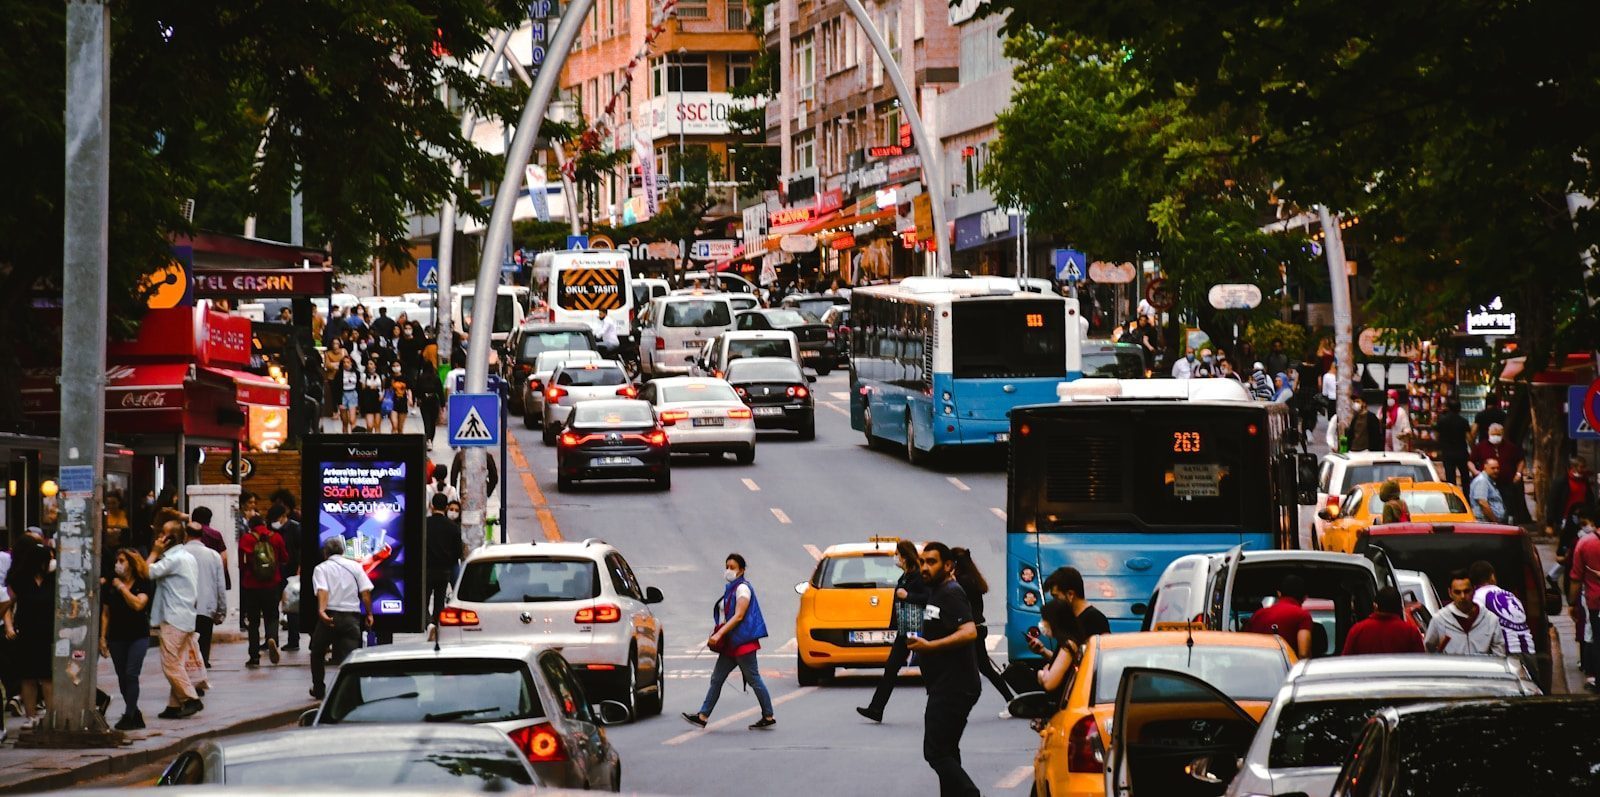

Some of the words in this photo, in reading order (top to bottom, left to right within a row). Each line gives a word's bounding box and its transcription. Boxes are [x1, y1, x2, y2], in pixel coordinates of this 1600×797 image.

[565, 285, 588, 294] OKUL
[1173, 432, 1200, 452] 263
[357, 468, 369, 476] her
[323, 486, 360, 498] Sözün
[362, 486, 383, 498] özü
[343, 501, 401, 516] söğütözü
